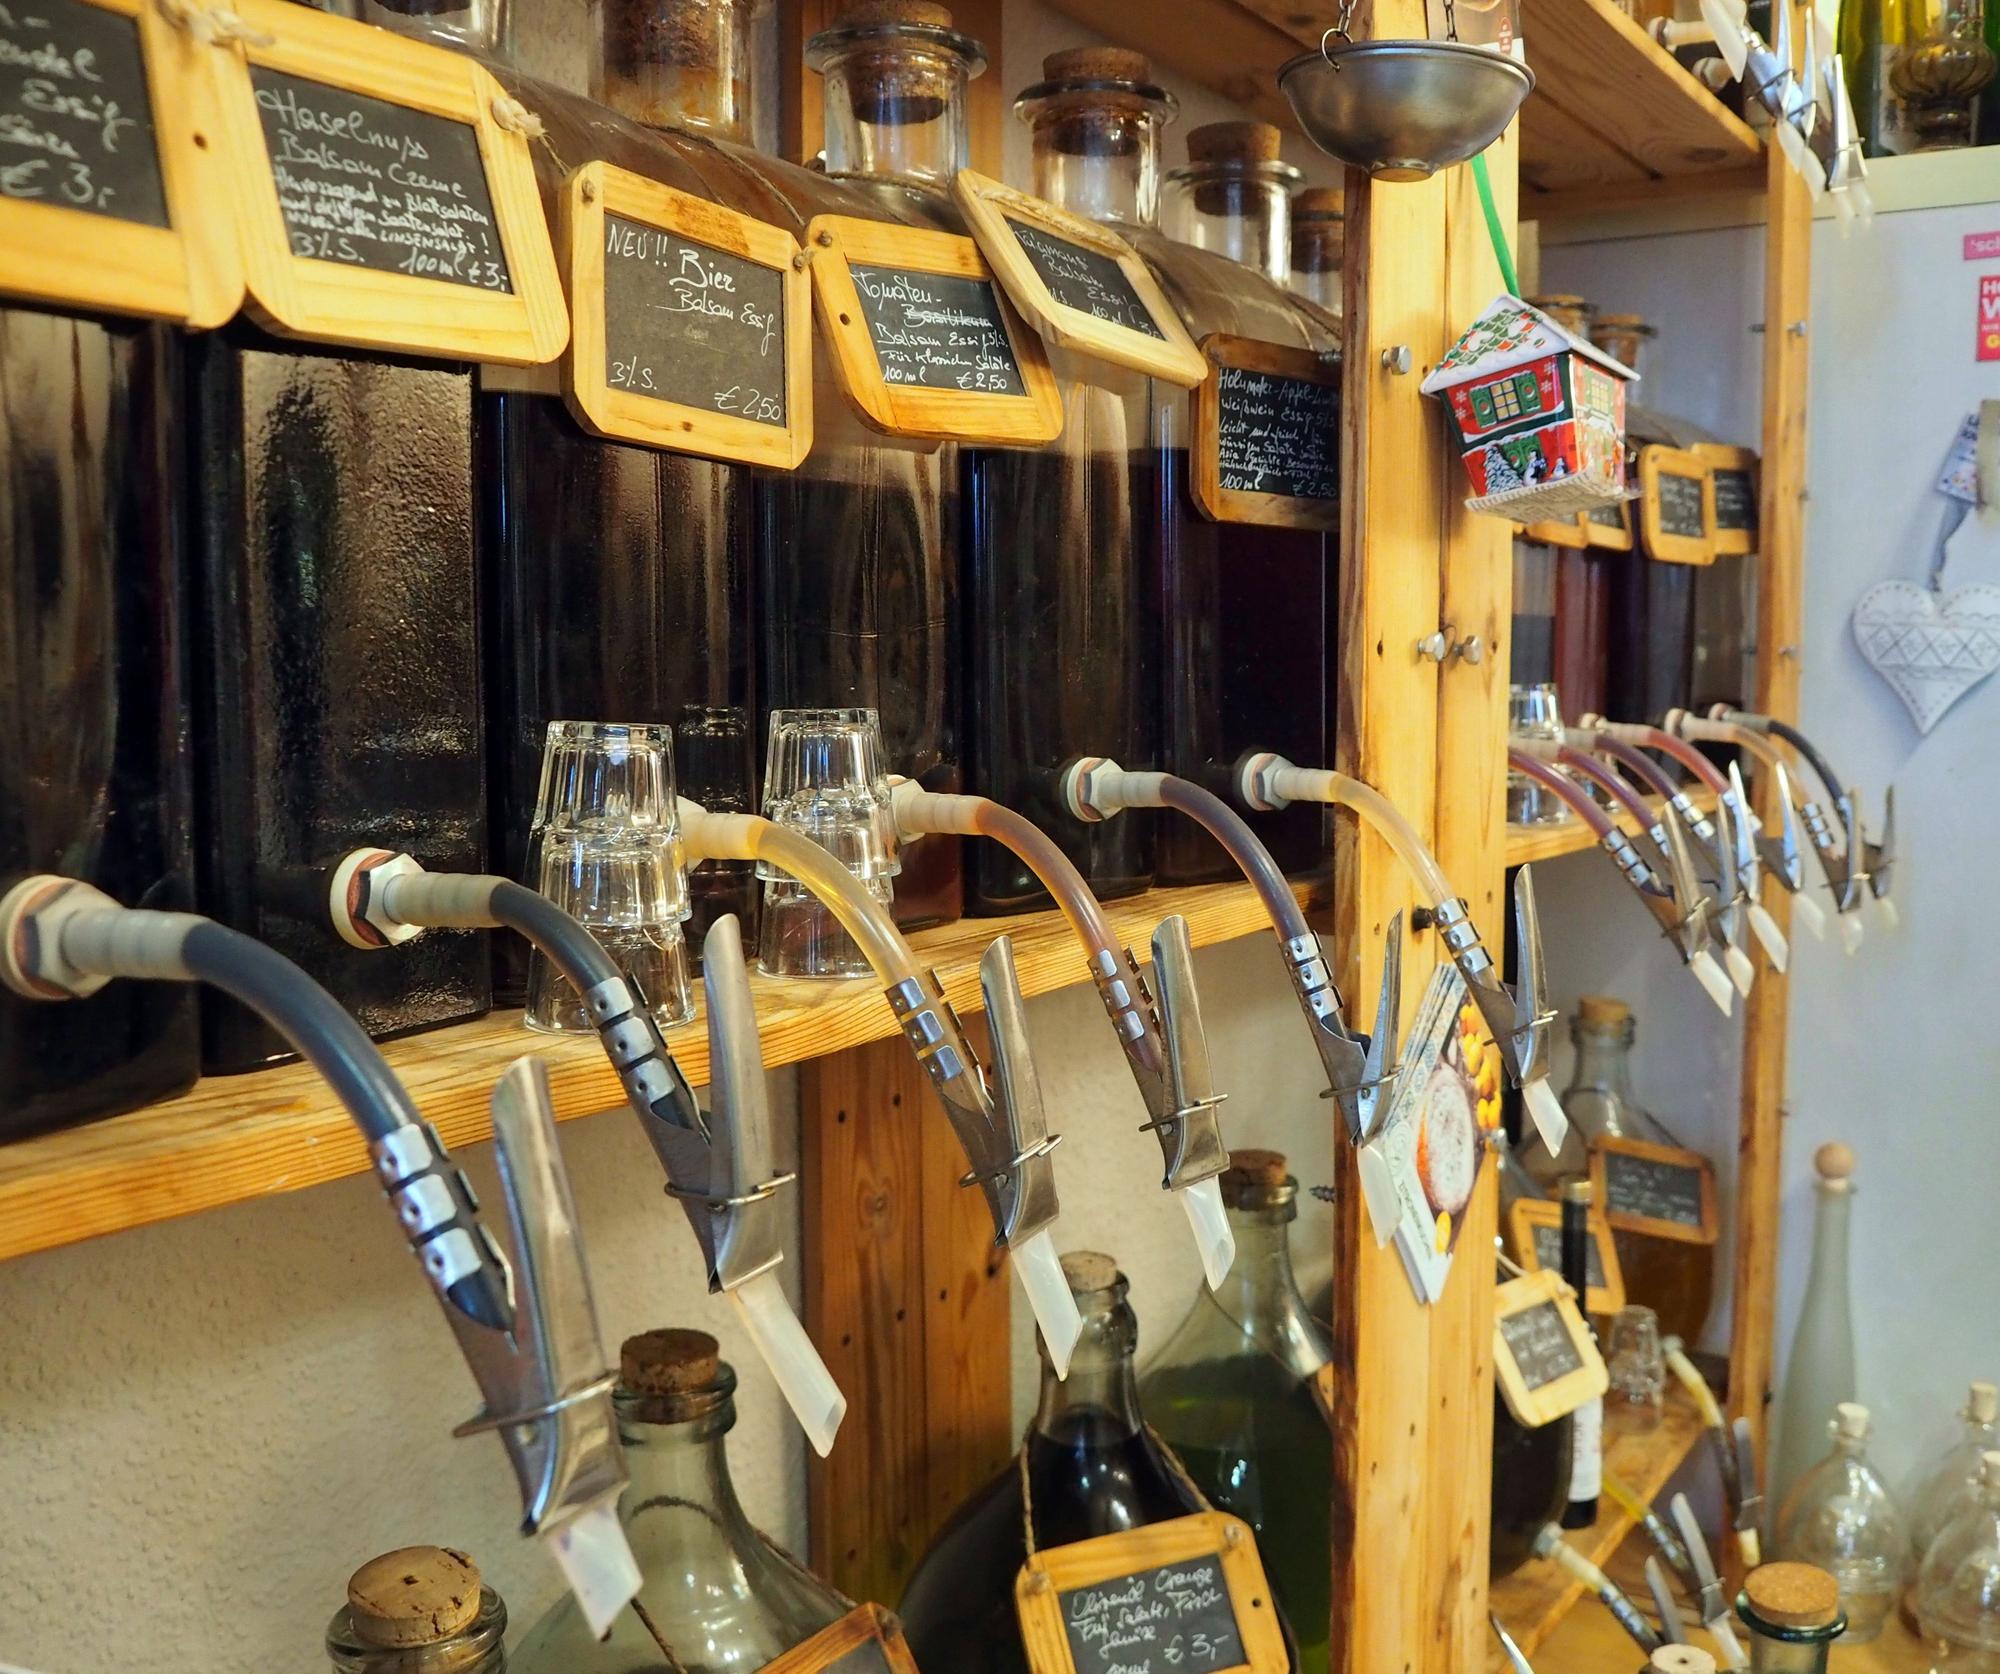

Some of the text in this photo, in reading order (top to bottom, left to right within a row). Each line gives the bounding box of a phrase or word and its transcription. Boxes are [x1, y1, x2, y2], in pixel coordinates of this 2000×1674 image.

[275, 128, 383, 178] Balsam
[668, 249, 736, 293] Bier
[653, 288, 734, 320] Balsam
[875, 322, 941, 347] Balsam
[976, 373, 1008, 391] 2,50
[743, 388, 782, 420] 2,50
